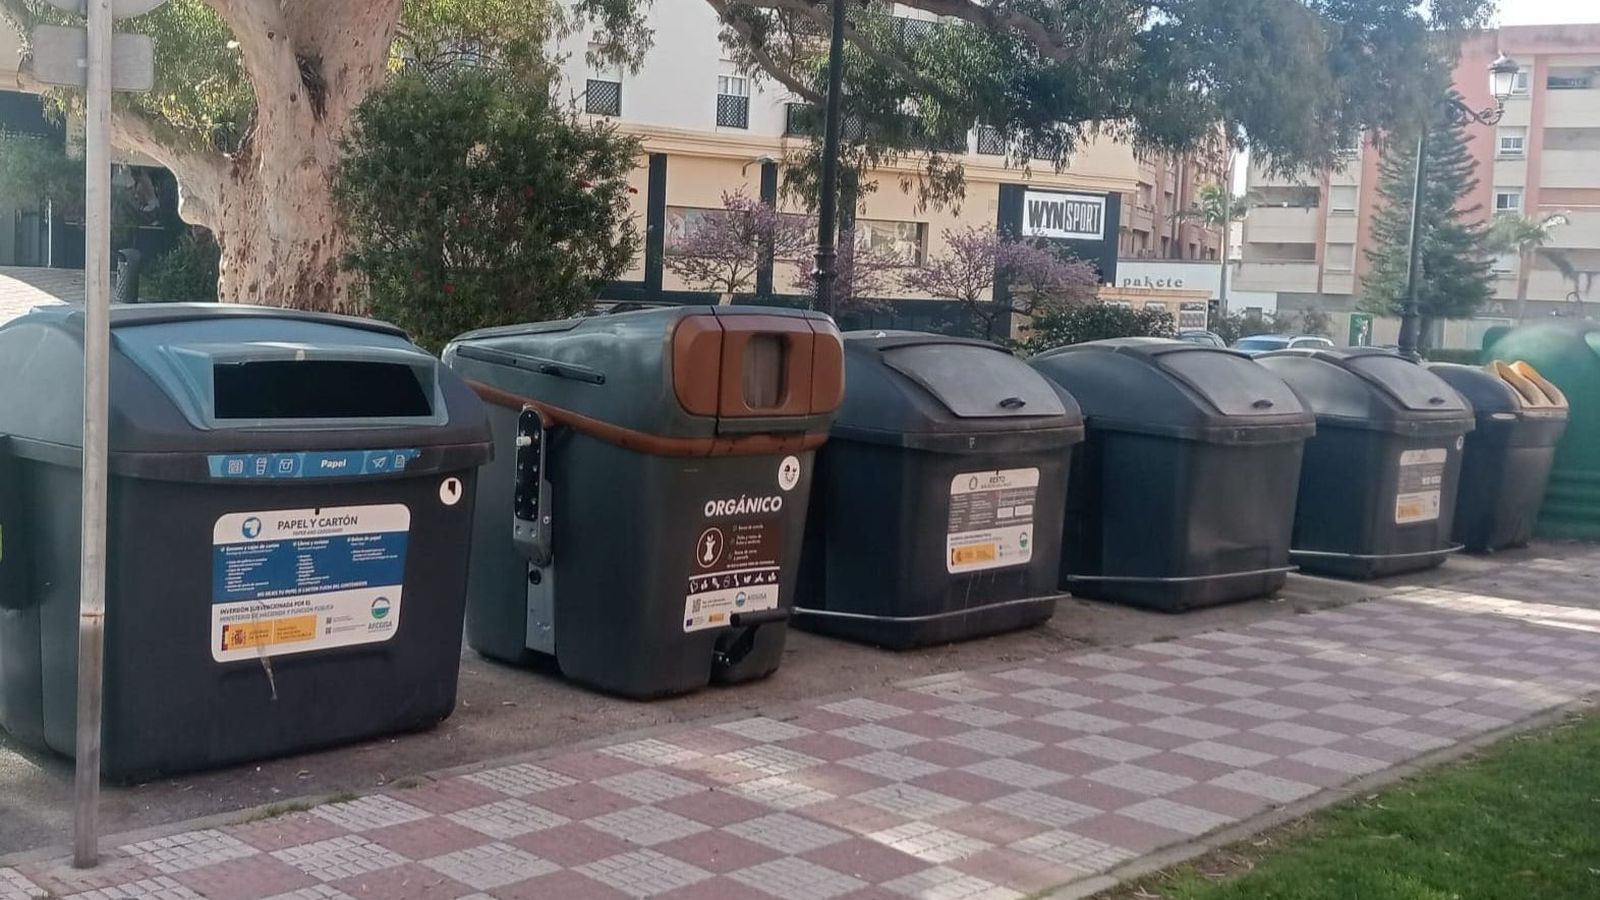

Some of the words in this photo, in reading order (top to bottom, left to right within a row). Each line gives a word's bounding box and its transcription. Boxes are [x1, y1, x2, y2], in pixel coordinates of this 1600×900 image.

[1028, 200, 1064, 230] WYN
[1066, 202, 1100, 233] SPORT
[1123, 275, 1184, 289] pakete
[321, 458, 346, 469] Papel
[704, 494, 782, 517] ORGÁNICO
[277, 519, 308, 530] PAPEL
[310, 518, 317, 528] Y
[318, 514, 358, 528] CARTÓN
